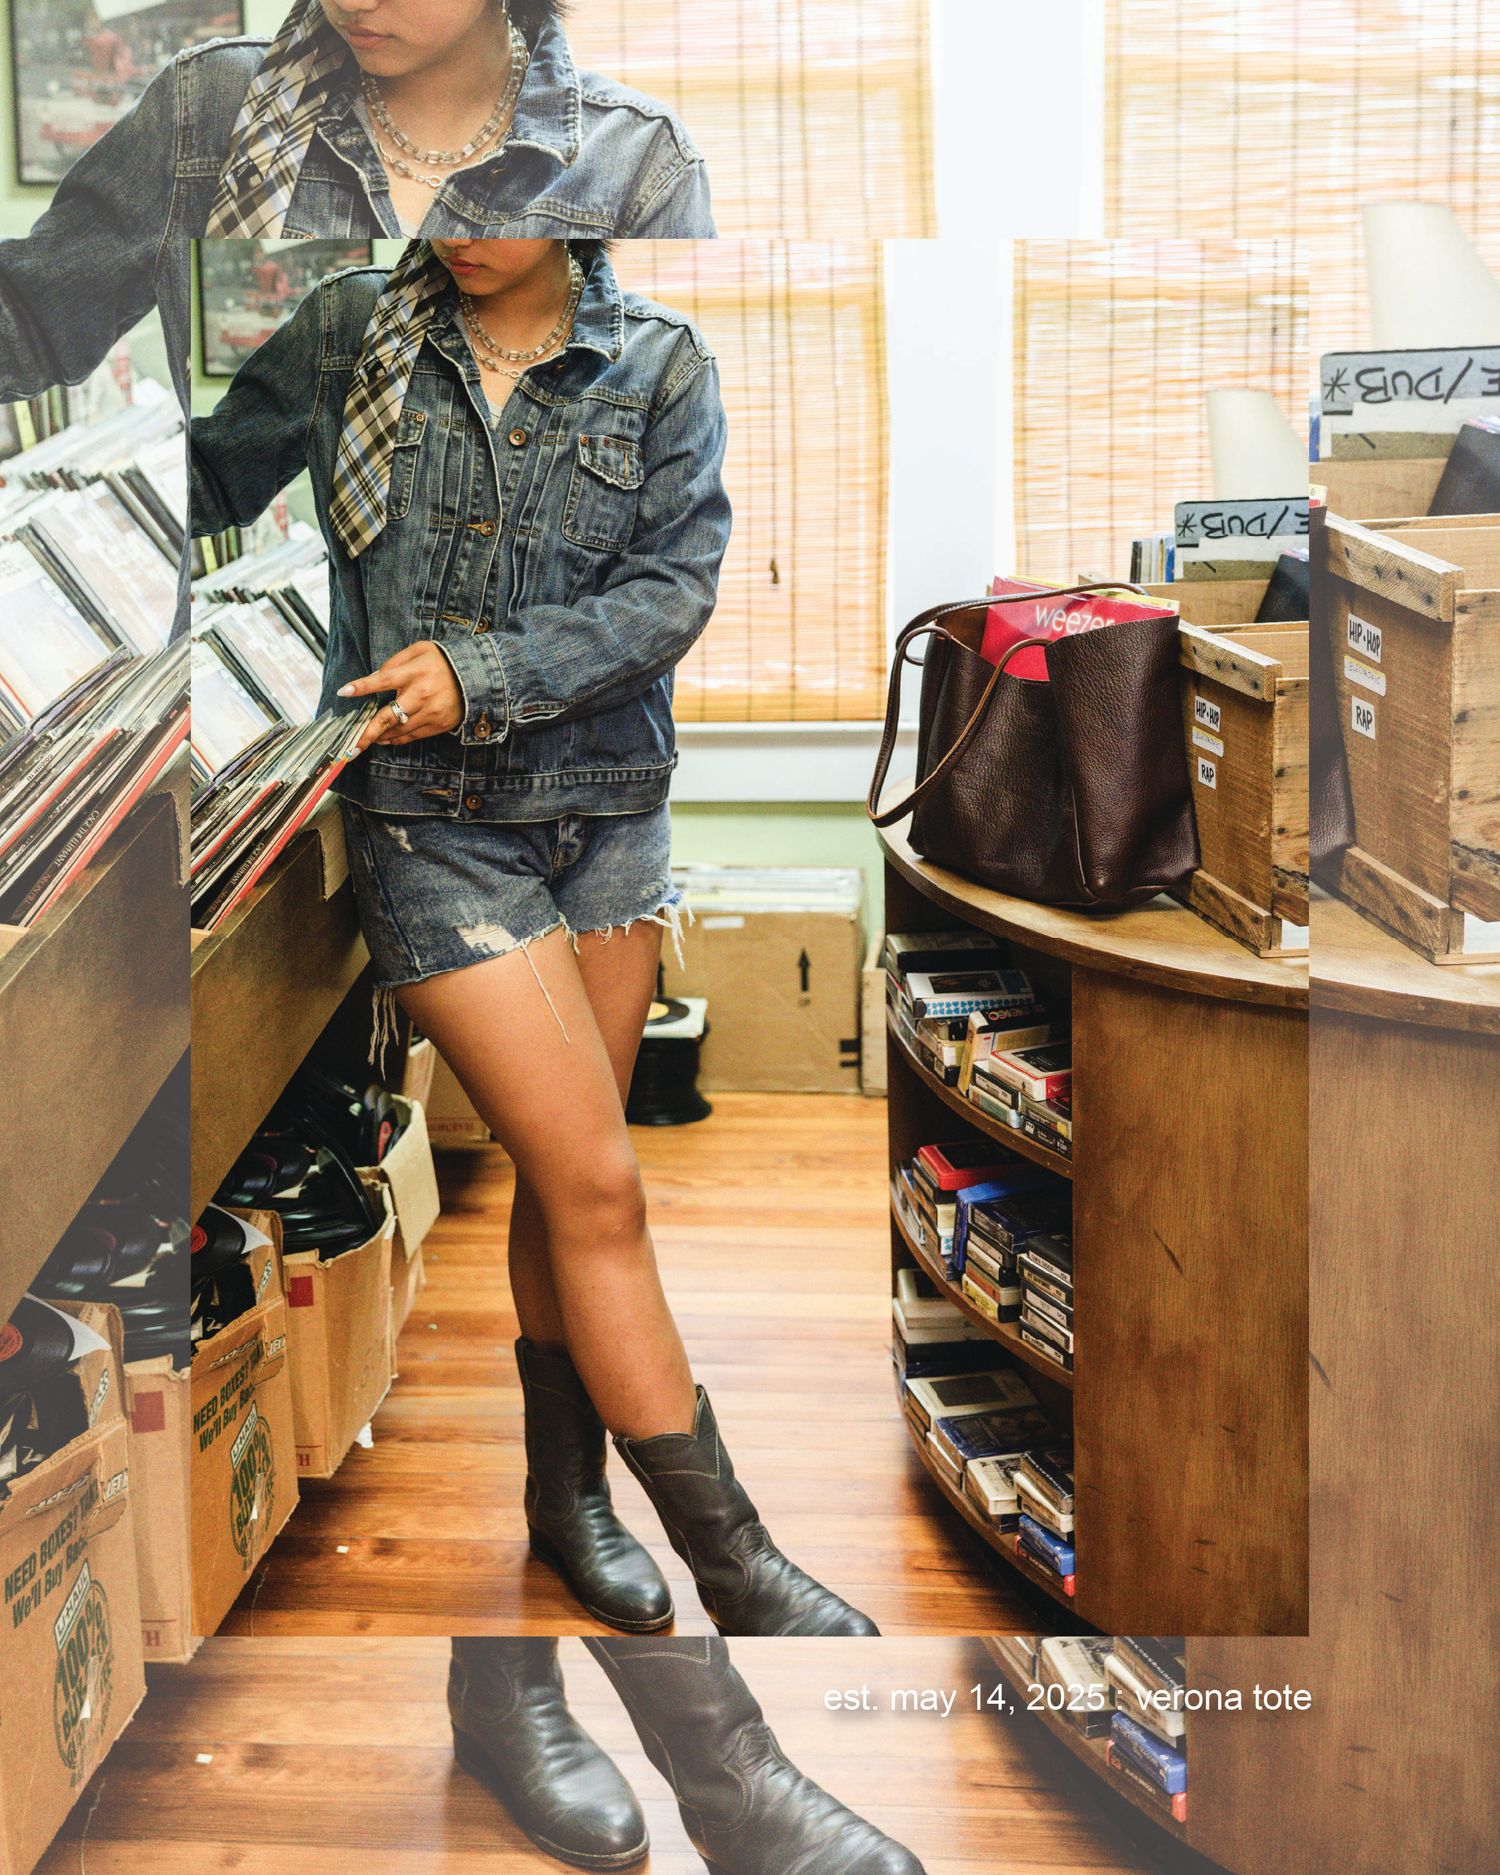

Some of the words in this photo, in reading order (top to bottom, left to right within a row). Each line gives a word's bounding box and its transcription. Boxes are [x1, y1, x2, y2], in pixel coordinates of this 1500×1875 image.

[1356, 705, 1373, 730] RAP
[1201, 764, 1214, 783] RAP
[193, 1395, 218, 1434] NEED
[199, 1415, 222, 1454] We'll
[223, 1402, 238, 1429] Buy
[4, 1552, 37, 1604] NEED
[12, 1578, 41, 1629] We'll
[44, 1559, 64, 1597] Buy
